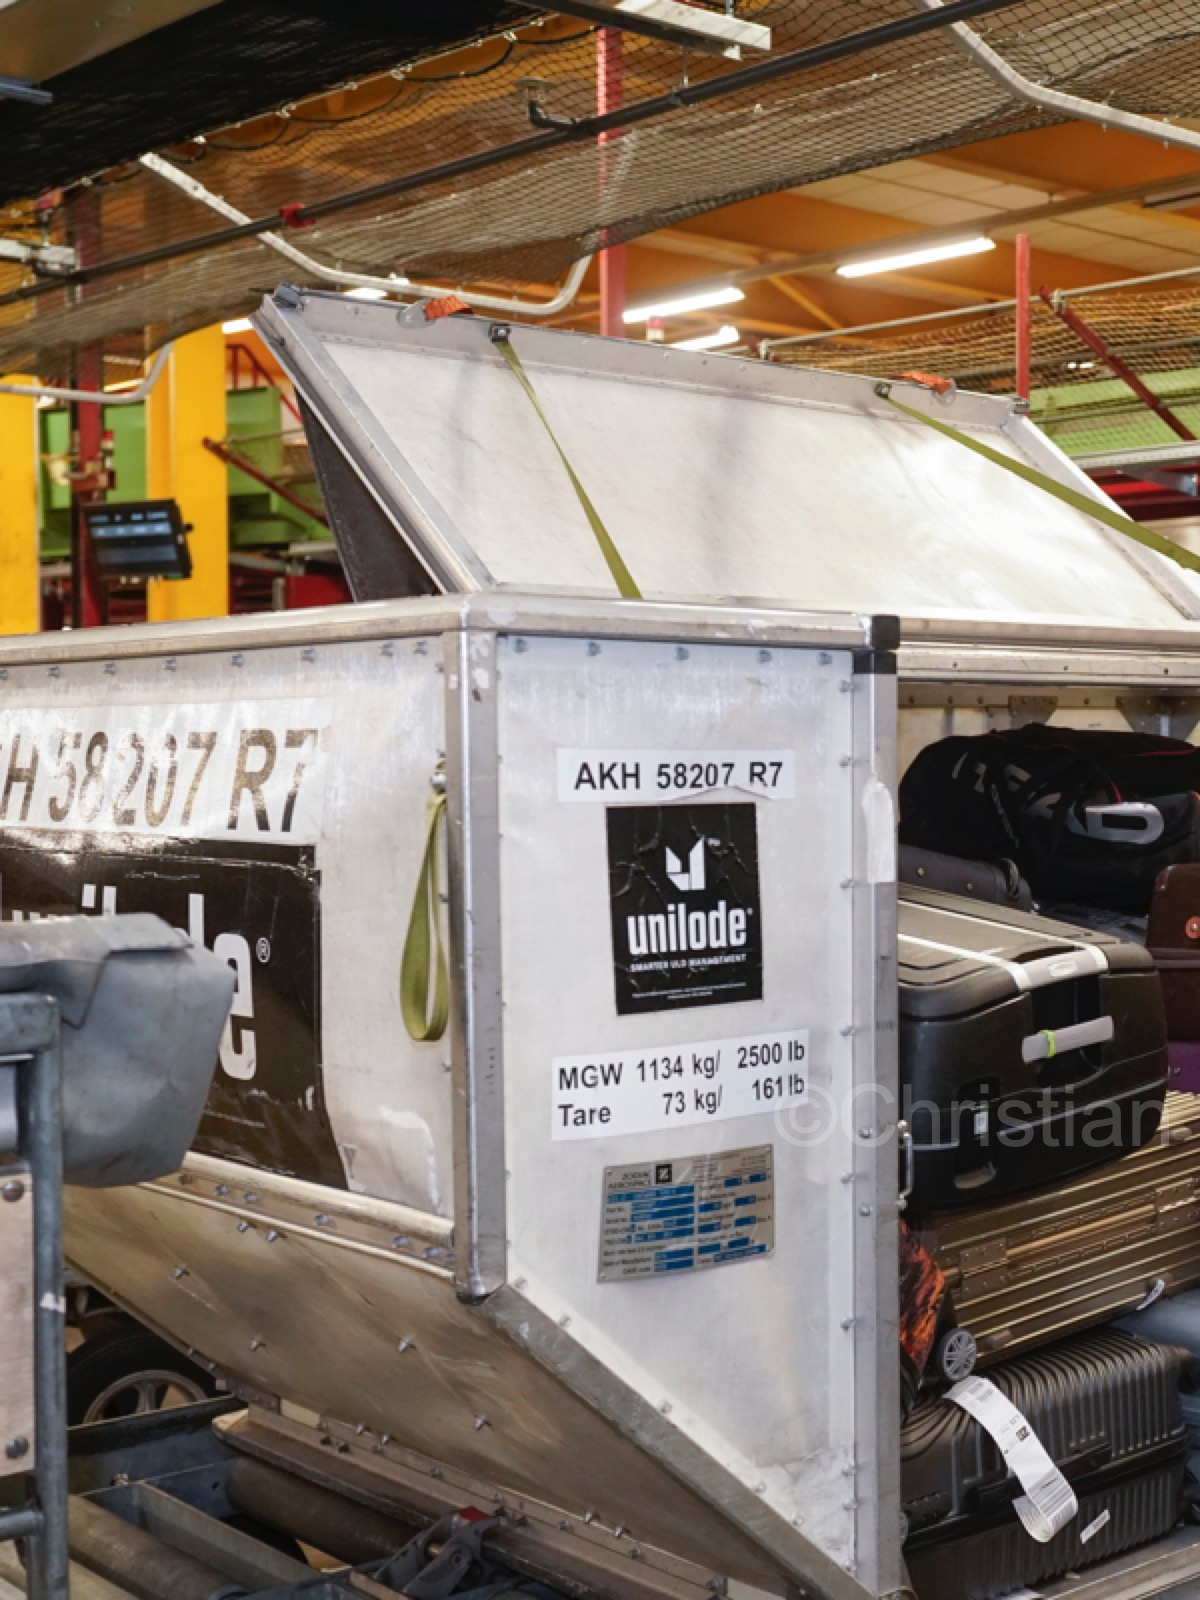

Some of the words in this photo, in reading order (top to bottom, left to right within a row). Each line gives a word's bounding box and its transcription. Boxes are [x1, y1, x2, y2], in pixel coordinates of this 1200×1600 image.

[0, 733, 39, 821] H
[48, 730, 218, 829] 58207
[227, 727, 318, 832] R7
[574, 761, 641, 790] AKH
[656, 762, 735, 789] 58207
[749, 761, 783, 788] R7
[627, 900, 747, 955] unilode
[558, 1062, 624, 1090] MGW
[636, 1055, 684, 1082] 1134
[691, 1050, 721, 1079] kg/
[737, 1042, 783, 1068] 2500
[787, 1039, 806, 1062] lb
[558, 1103, 612, 1127] Tare
[662, 1091, 686, 1115] 73
[693, 1084, 723, 1115] kg/
[751, 1075, 784, 1100] 161
[788, 1073, 806, 1095] lb
